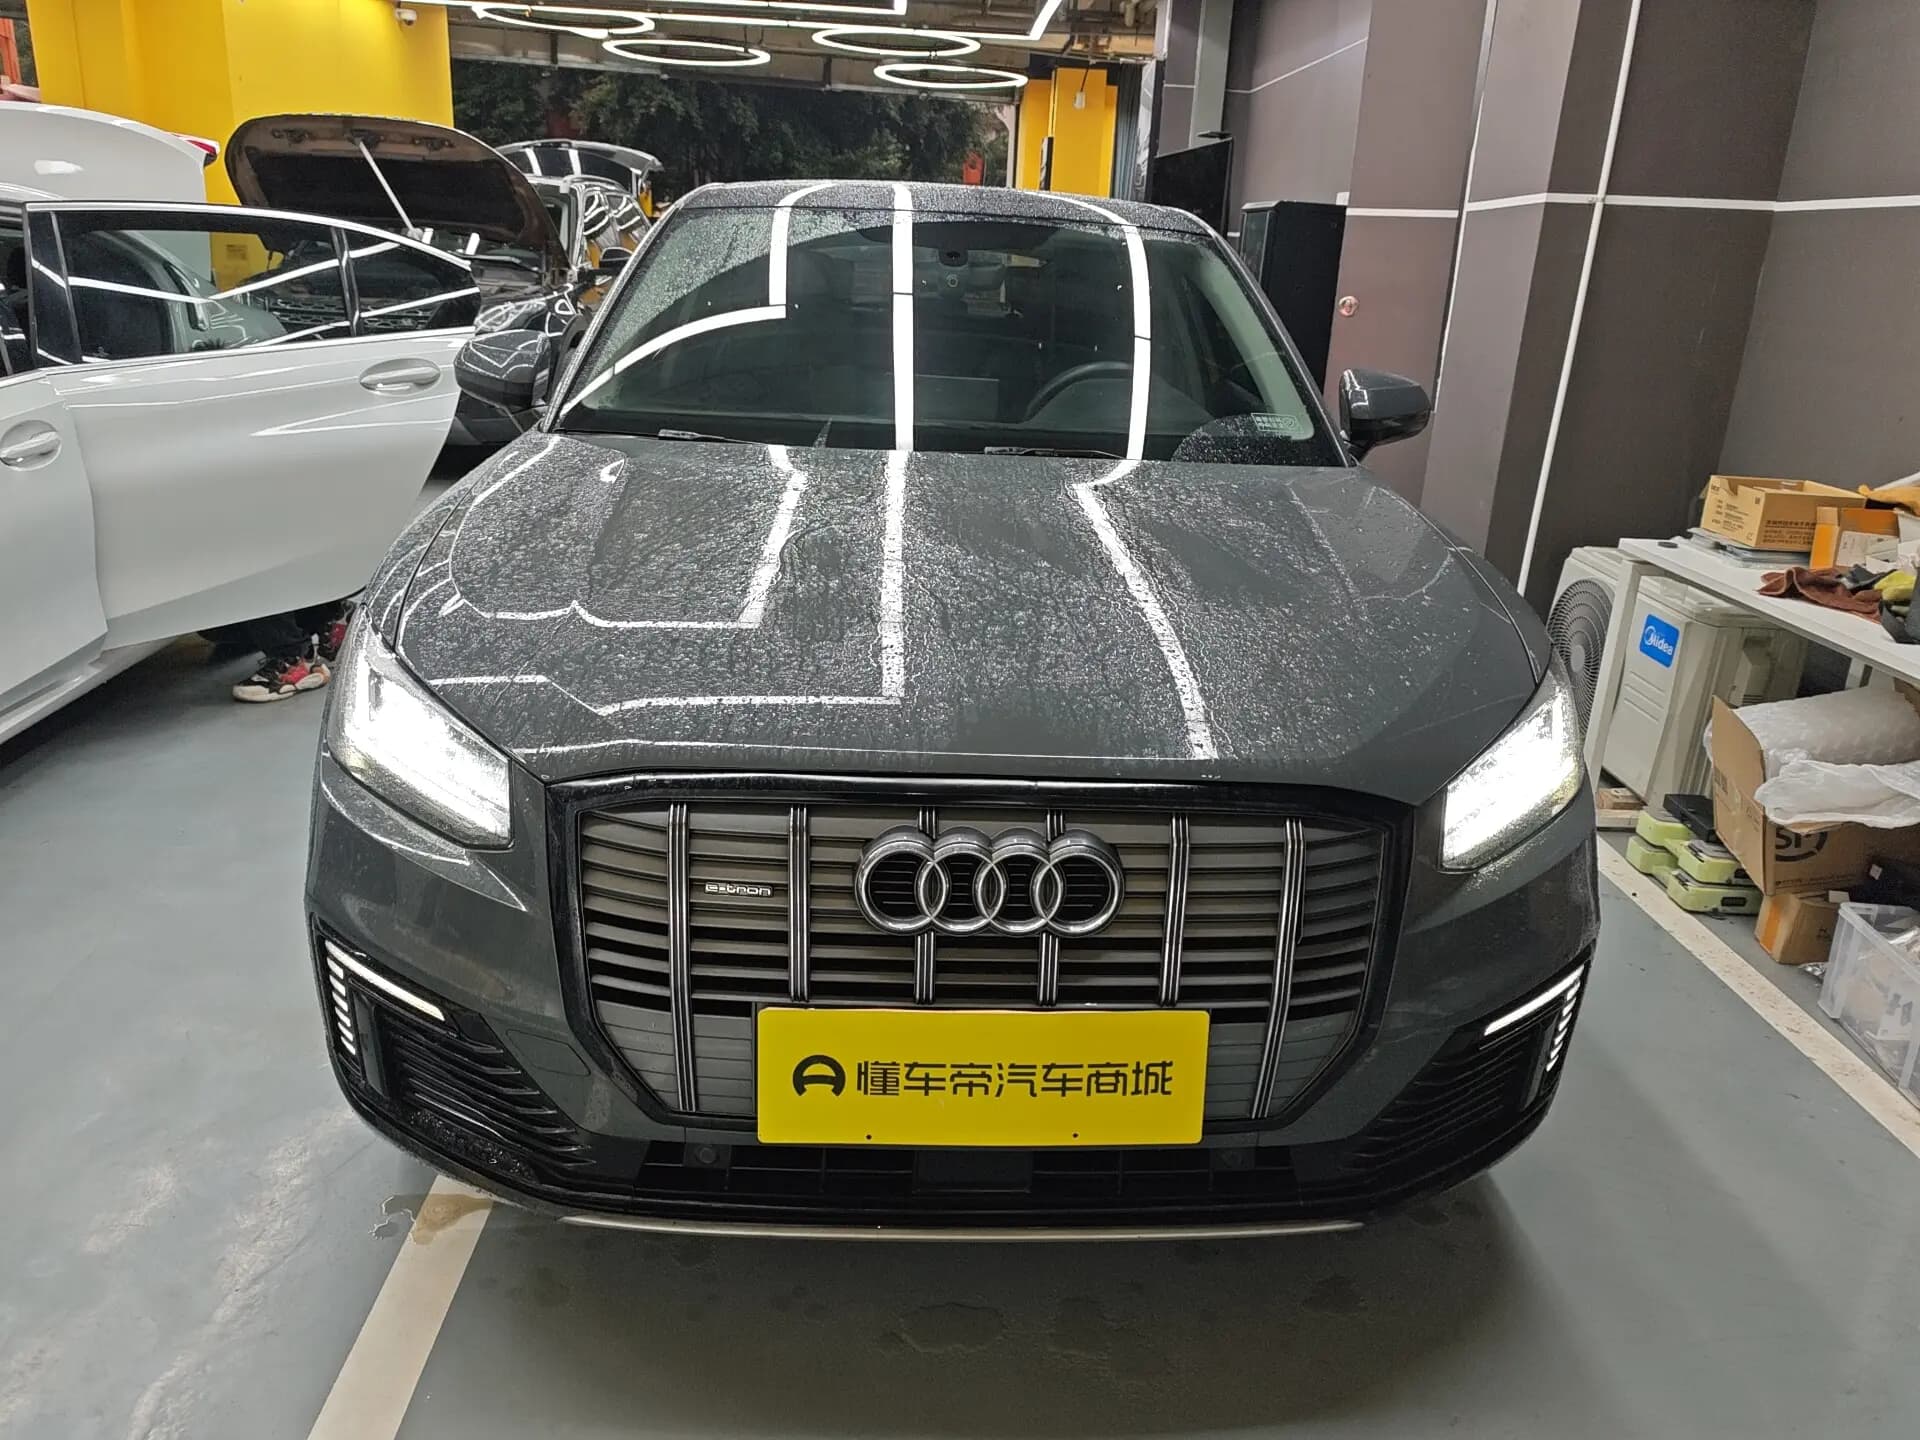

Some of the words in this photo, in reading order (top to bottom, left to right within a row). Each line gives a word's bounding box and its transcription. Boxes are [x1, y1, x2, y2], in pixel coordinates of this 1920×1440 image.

[1644, 625, 1674, 656] Midea
[705, 882, 772, 897] e-tron
[857, 1060, 1174, 1098] 懂车帝汽车商城
